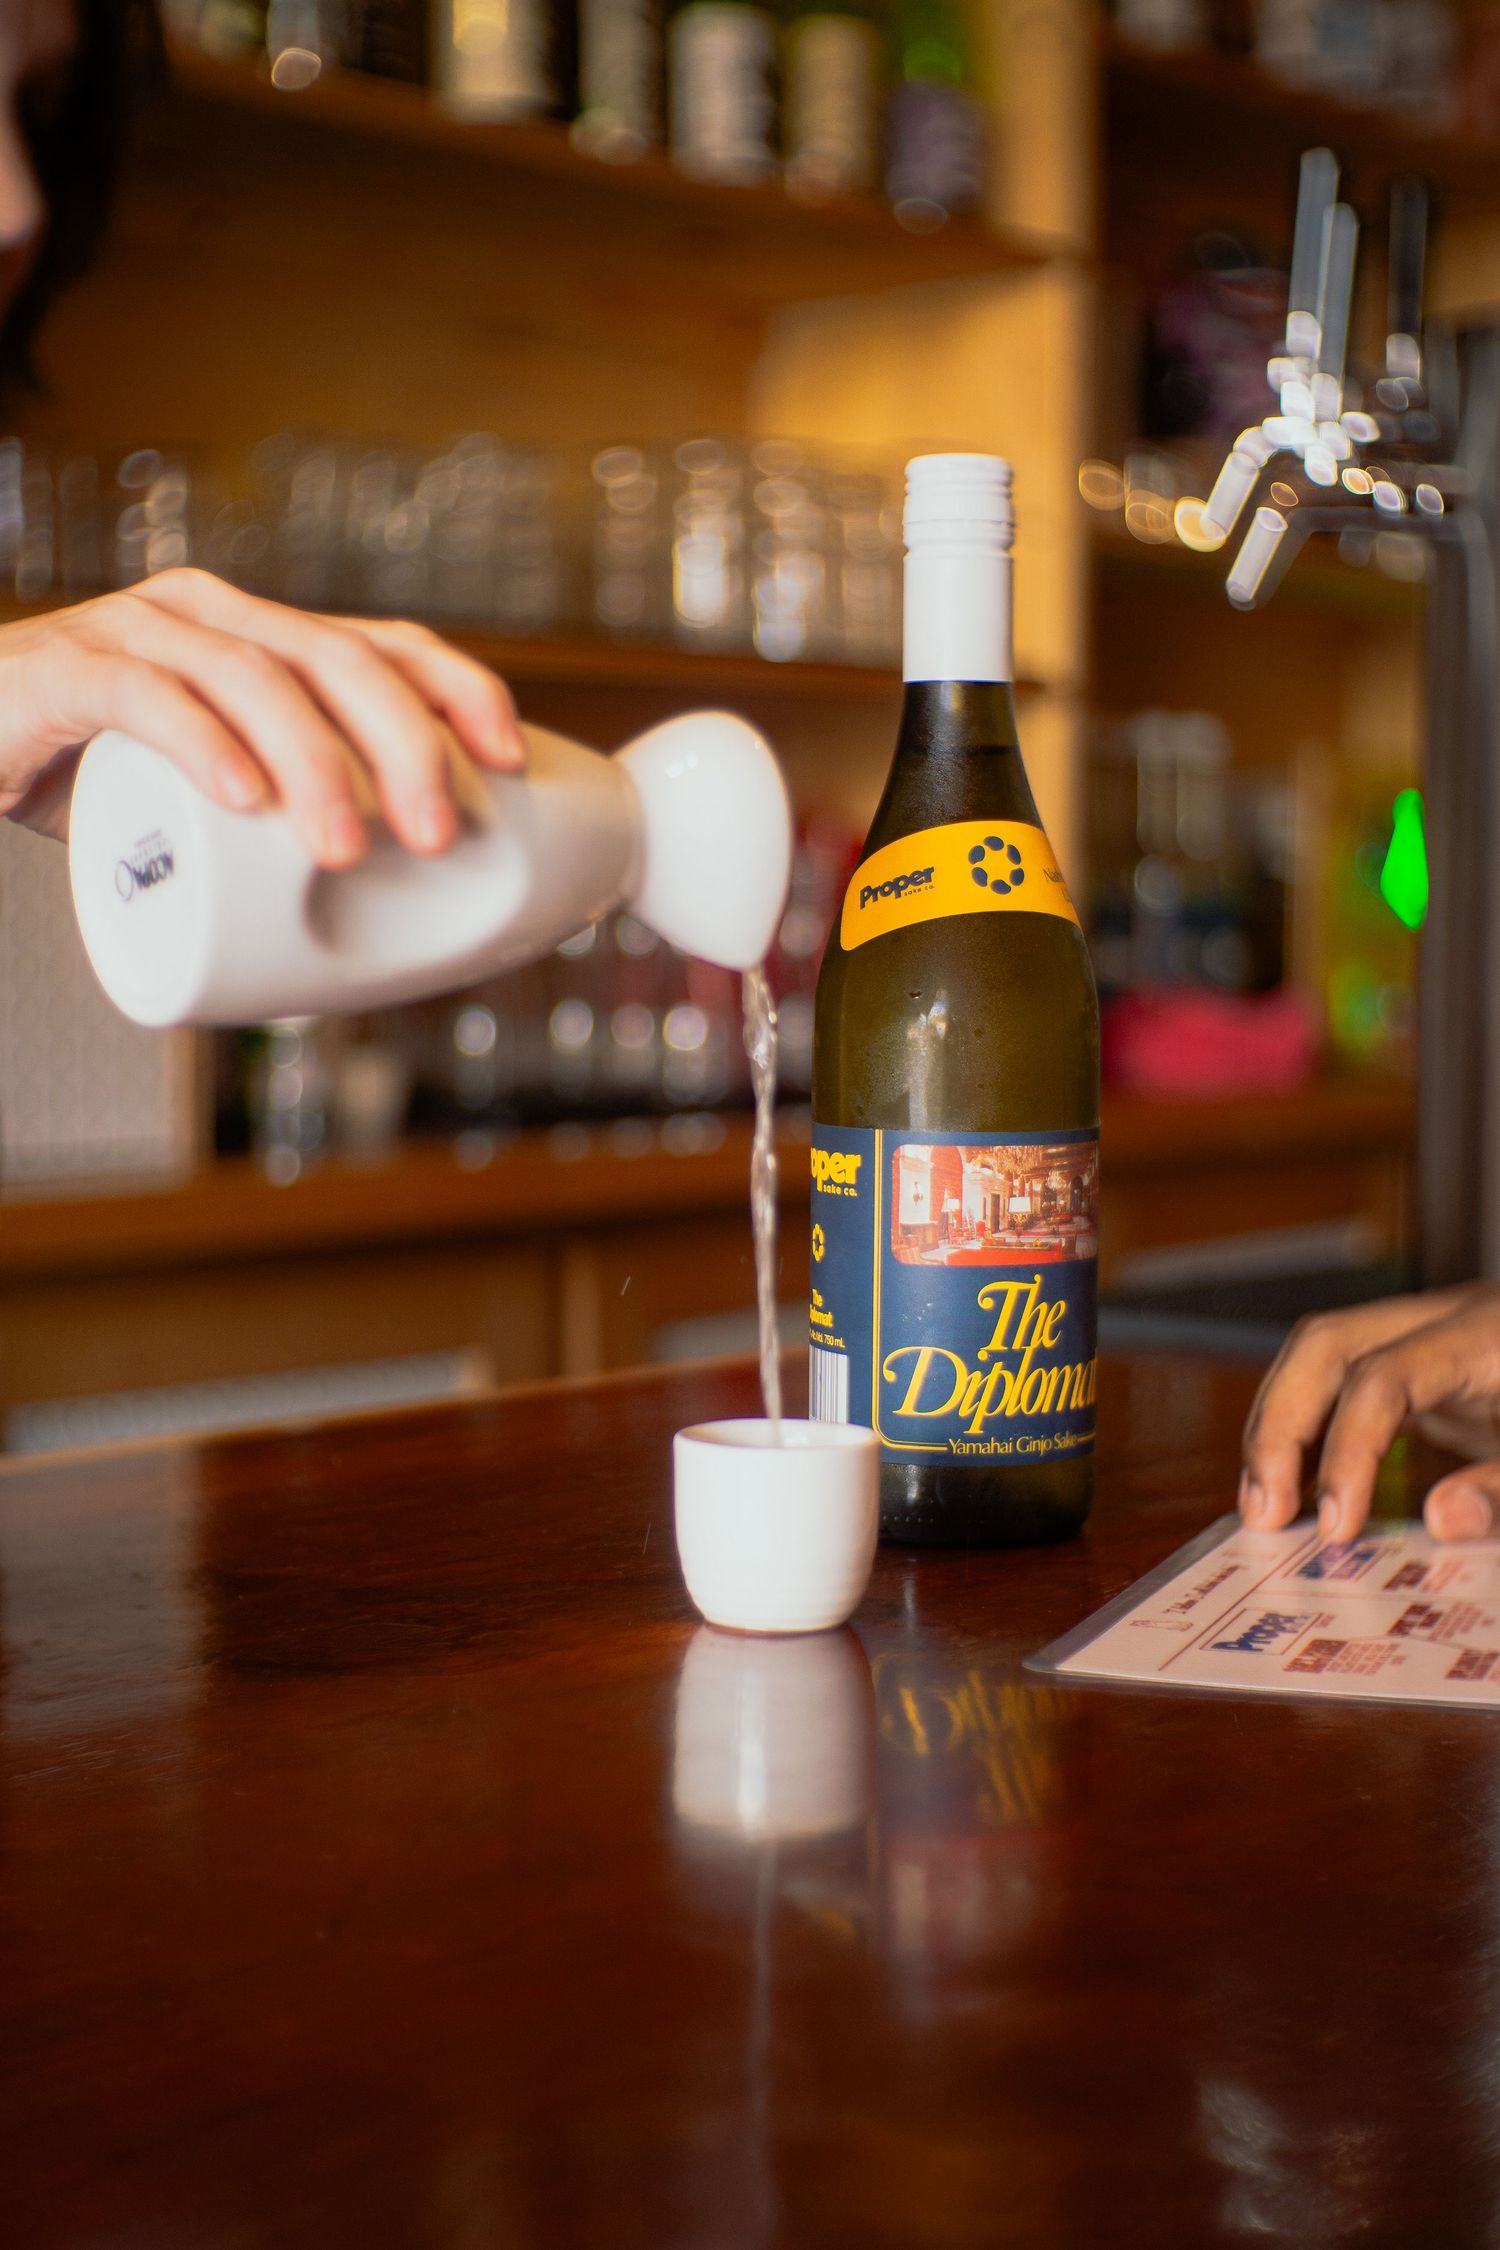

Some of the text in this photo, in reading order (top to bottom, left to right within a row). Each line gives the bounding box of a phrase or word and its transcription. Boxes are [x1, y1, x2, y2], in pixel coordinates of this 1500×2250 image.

[859, 866, 935, 910] Proper
[810, 1147, 862, 1192] oper
[823, 1184, 858, 1197] sake co.
[977, 1274, 1067, 1351] The
[824, 1333, 834, 1346] 750
[948, 1430, 1078, 1457] Yamahai Ginjo Sake
